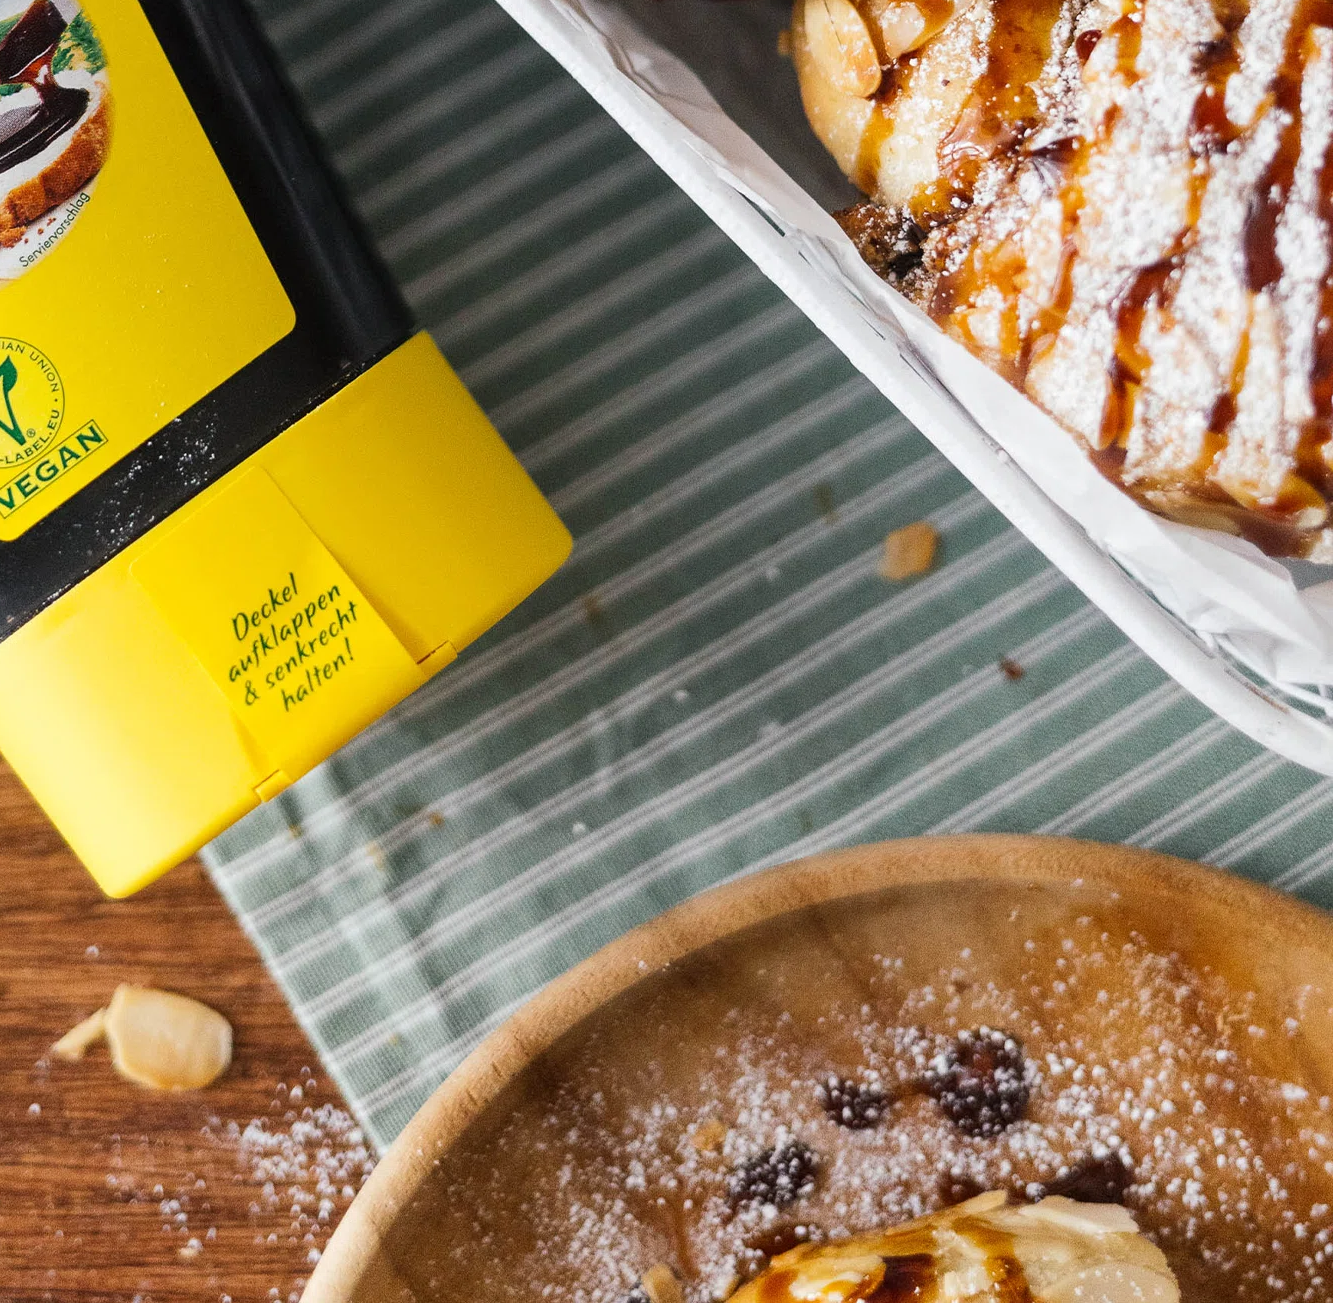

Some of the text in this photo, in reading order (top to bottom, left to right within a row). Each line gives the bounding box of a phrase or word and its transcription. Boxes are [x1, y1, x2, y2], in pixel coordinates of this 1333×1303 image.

[18, 191, 92, 268] Serviervorschlag
[29, 351, 60, 394] UNION
[228, 584, 341, 683] aufklappen
[231, 571, 299, 642] Deckel
[244, 600, 358, 706] & senkrecht
[280, 636, 355, 713] halten!
